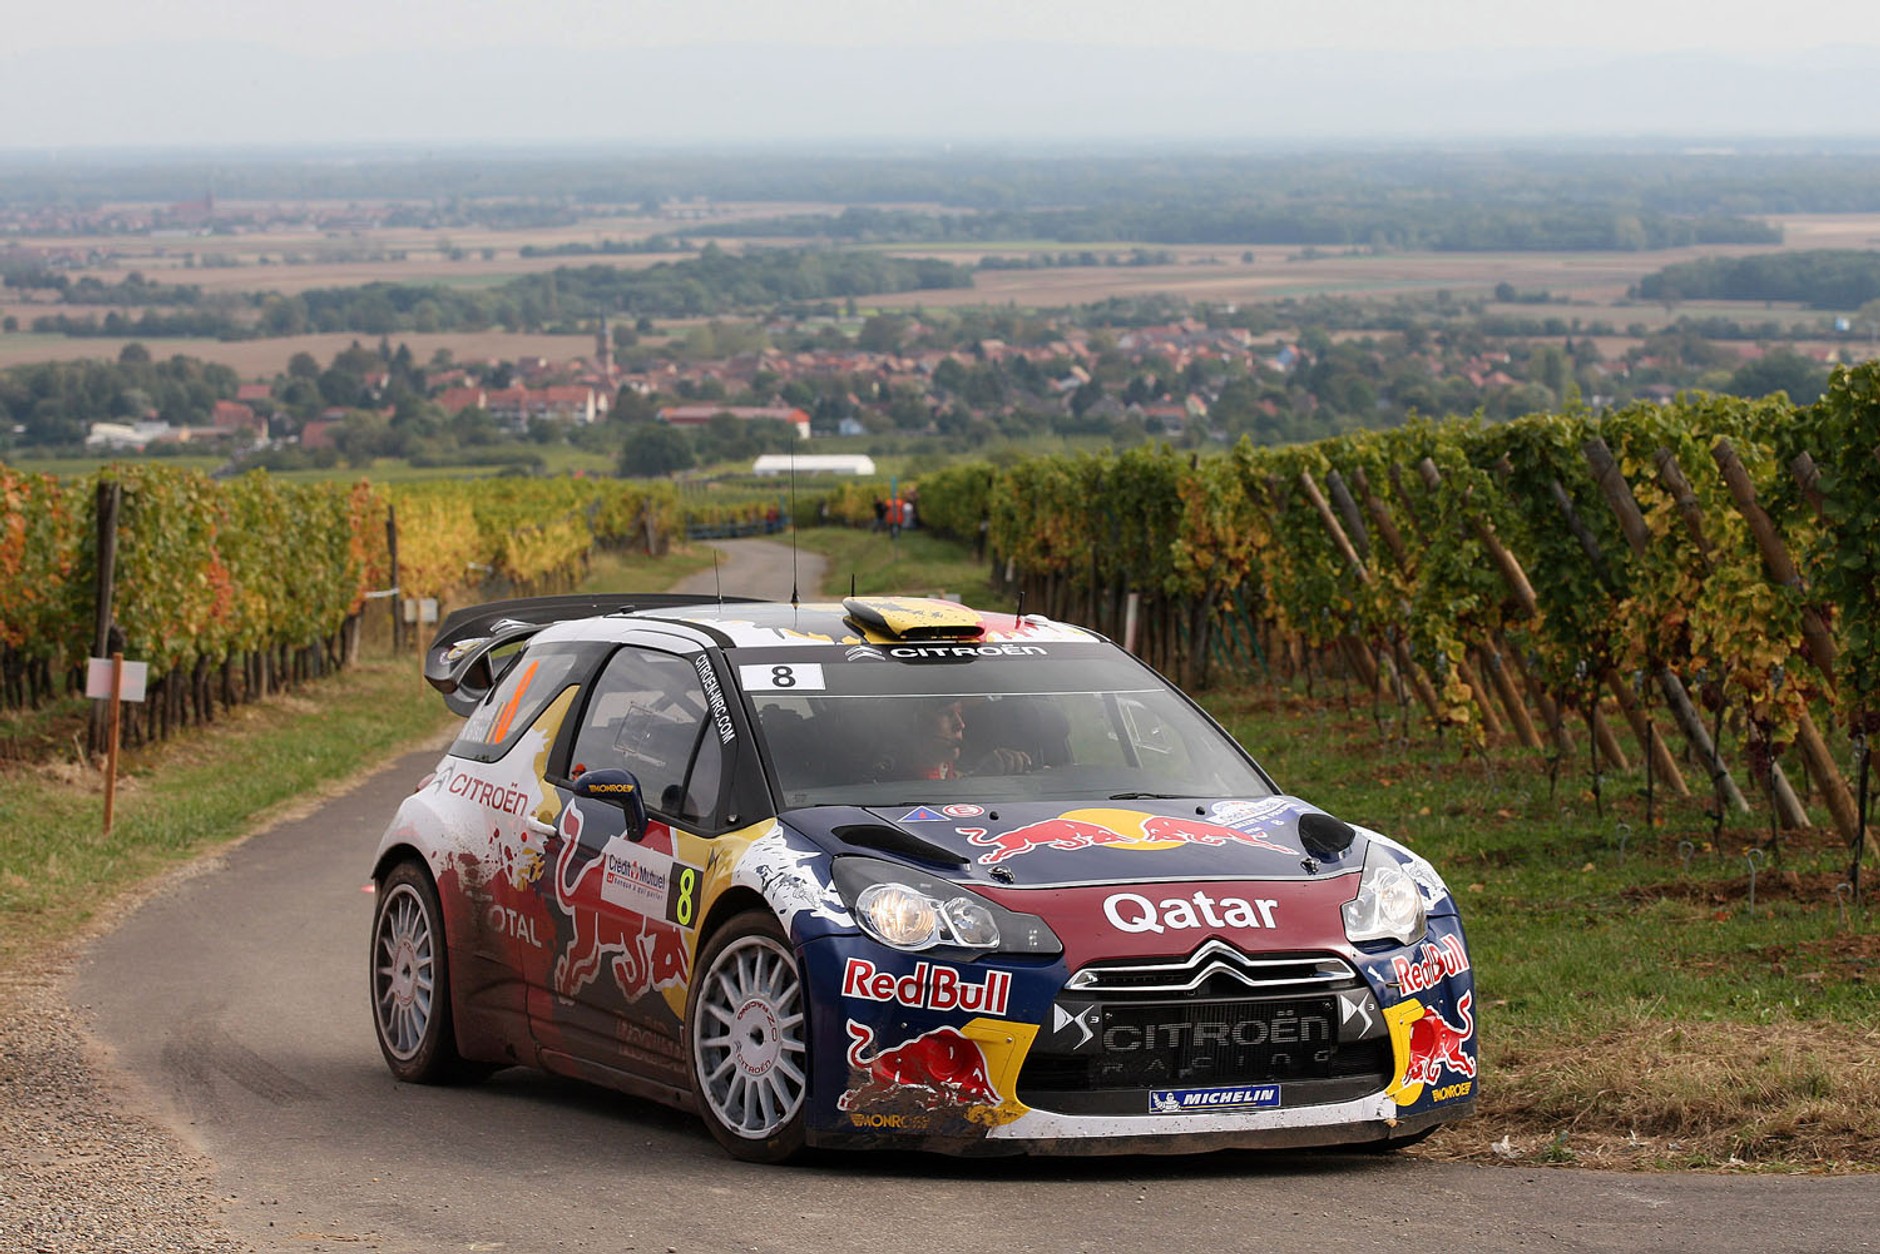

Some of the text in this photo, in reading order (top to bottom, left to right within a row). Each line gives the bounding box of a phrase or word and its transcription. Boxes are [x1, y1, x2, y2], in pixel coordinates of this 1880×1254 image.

[772, 665, 796, 687] 8
[609, 854, 631, 877] Crédit
[640, 866, 666, 890] Mutuel
[676, 868, 695, 926] 8
[1103, 890, 1279, 934] Qatar
[1183, 1089, 1275, 1106] MICHELIN
[1431, 1081, 1472, 1102] MONROE
